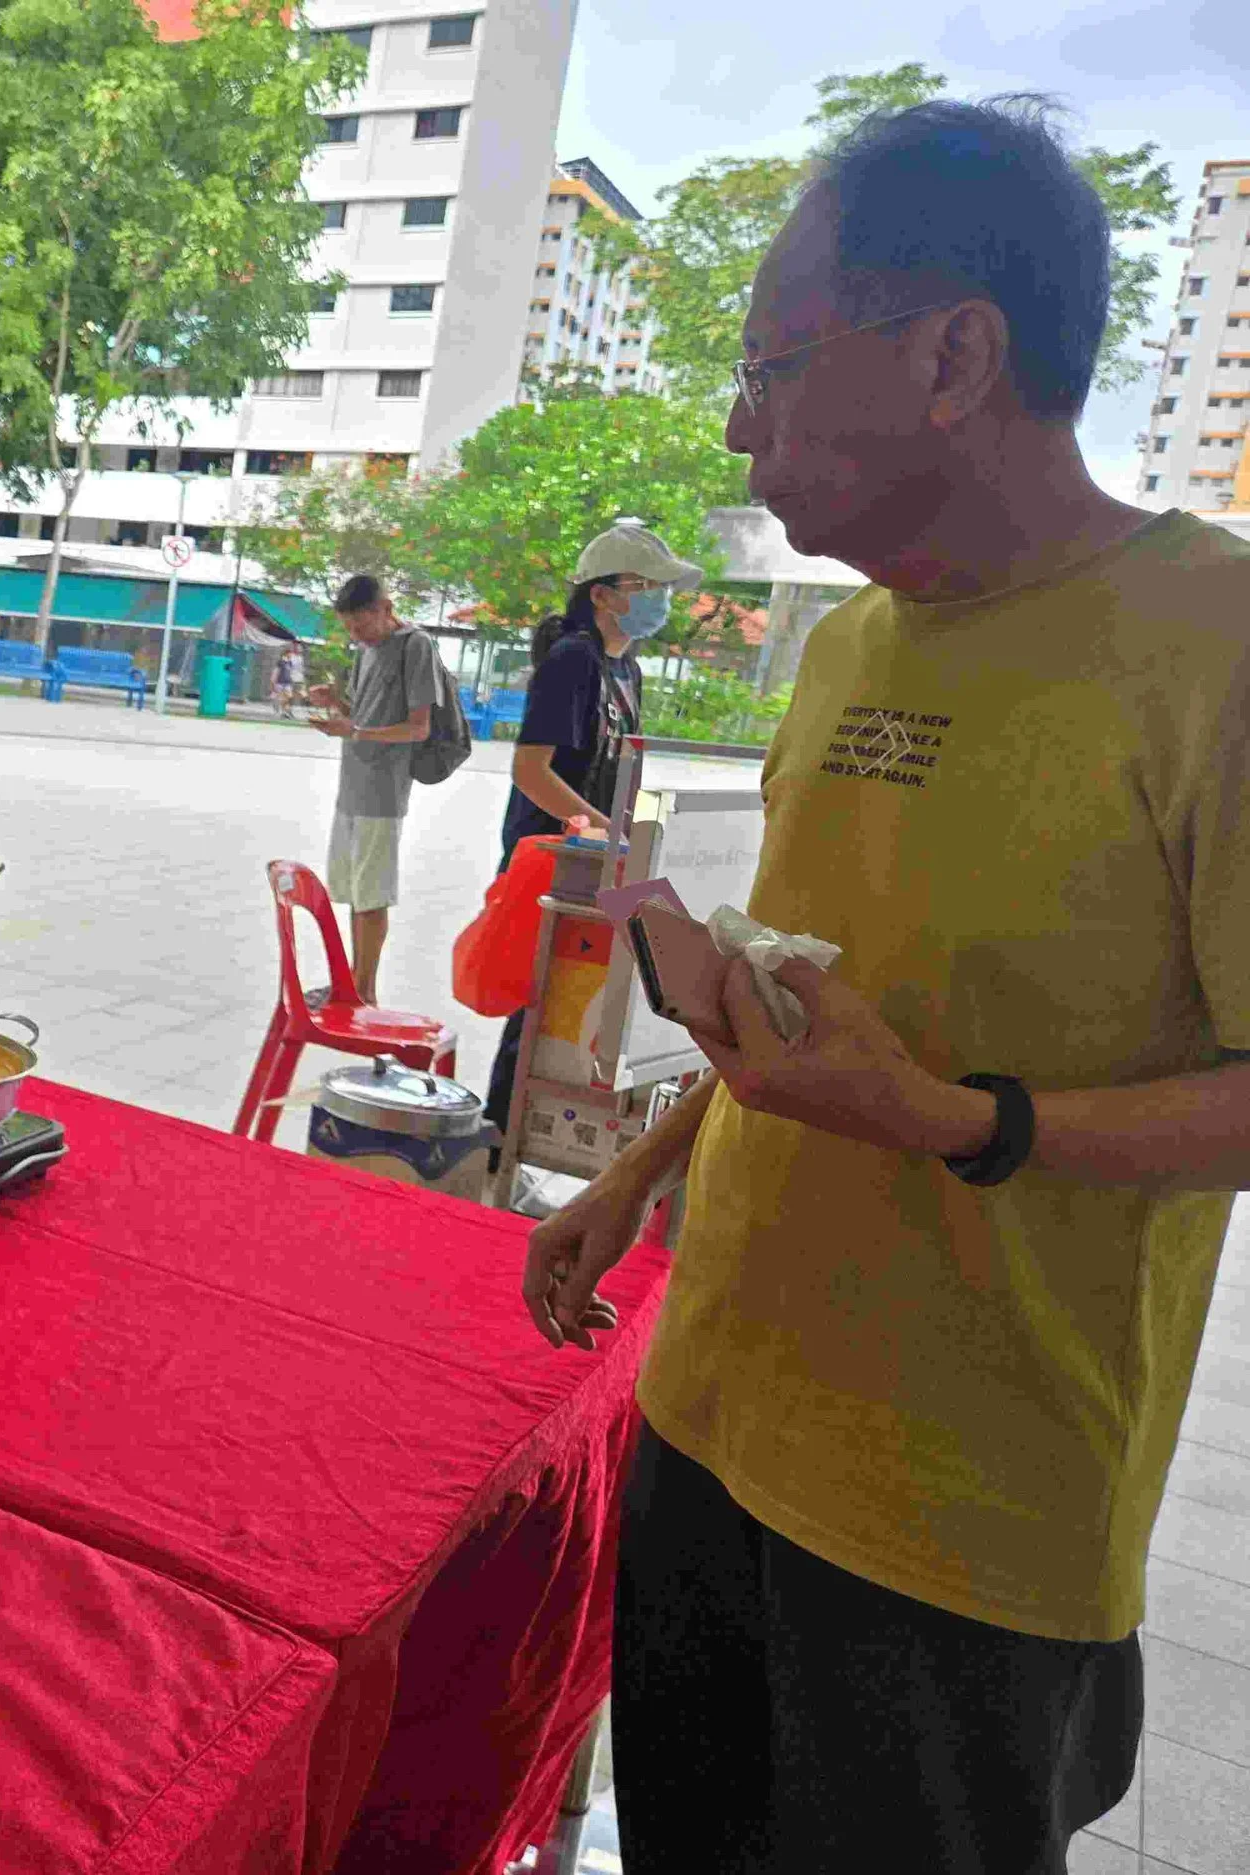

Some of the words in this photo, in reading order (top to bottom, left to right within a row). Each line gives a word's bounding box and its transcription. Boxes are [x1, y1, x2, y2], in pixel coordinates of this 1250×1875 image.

[906, 713, 915, 724] A
[919, 714, 953, 728] NEW
[931, 736, 942, 747] A
[820, 760, 844, 774] AND
